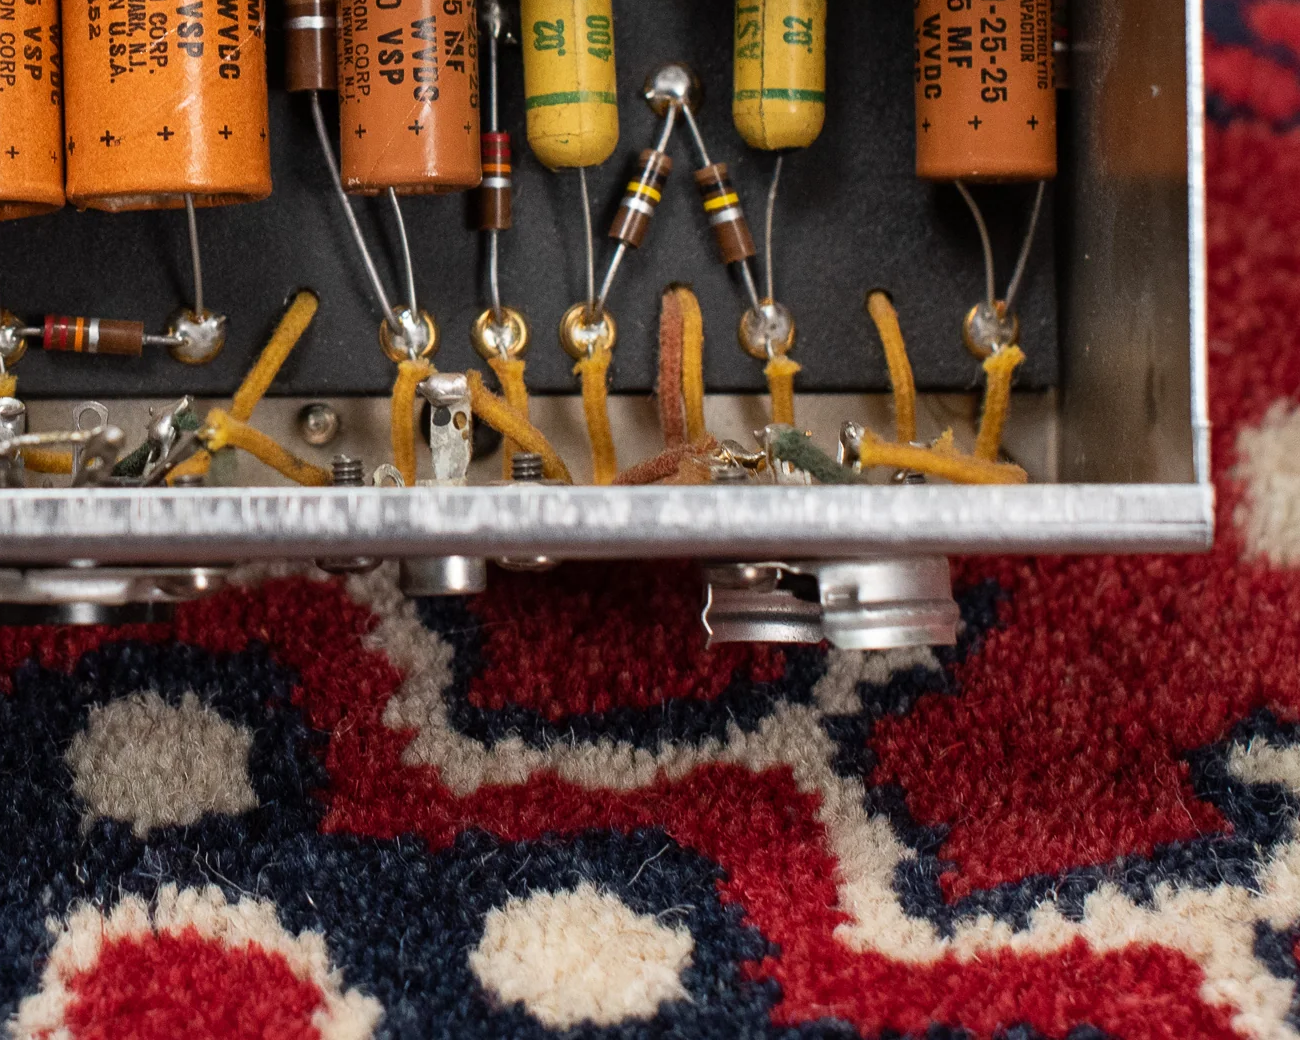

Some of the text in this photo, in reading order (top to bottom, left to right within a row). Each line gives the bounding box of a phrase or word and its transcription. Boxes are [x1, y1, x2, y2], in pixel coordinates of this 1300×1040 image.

[23, 26, 43, 81] VSP
[108, 21, 127, 84] U.S.A.
[128, 42, 147, 73] N.J.
[148, 12, 169, 75] CORP.
[175, 1, 204, 58] VSP
[376, 28, 405, 86] VSP
[444, 30, 465, 74] MF
[533, 18, 566, 56] .02
[585, 14, 612, 62] 400
[782, 16, 813, 54] .02
[922, 13, 942, 100] WVDC
[947, 26, 972, 69] MF
[0, 32, 16, 92] CORP.
[354, 43, 371, 104] CORP.
